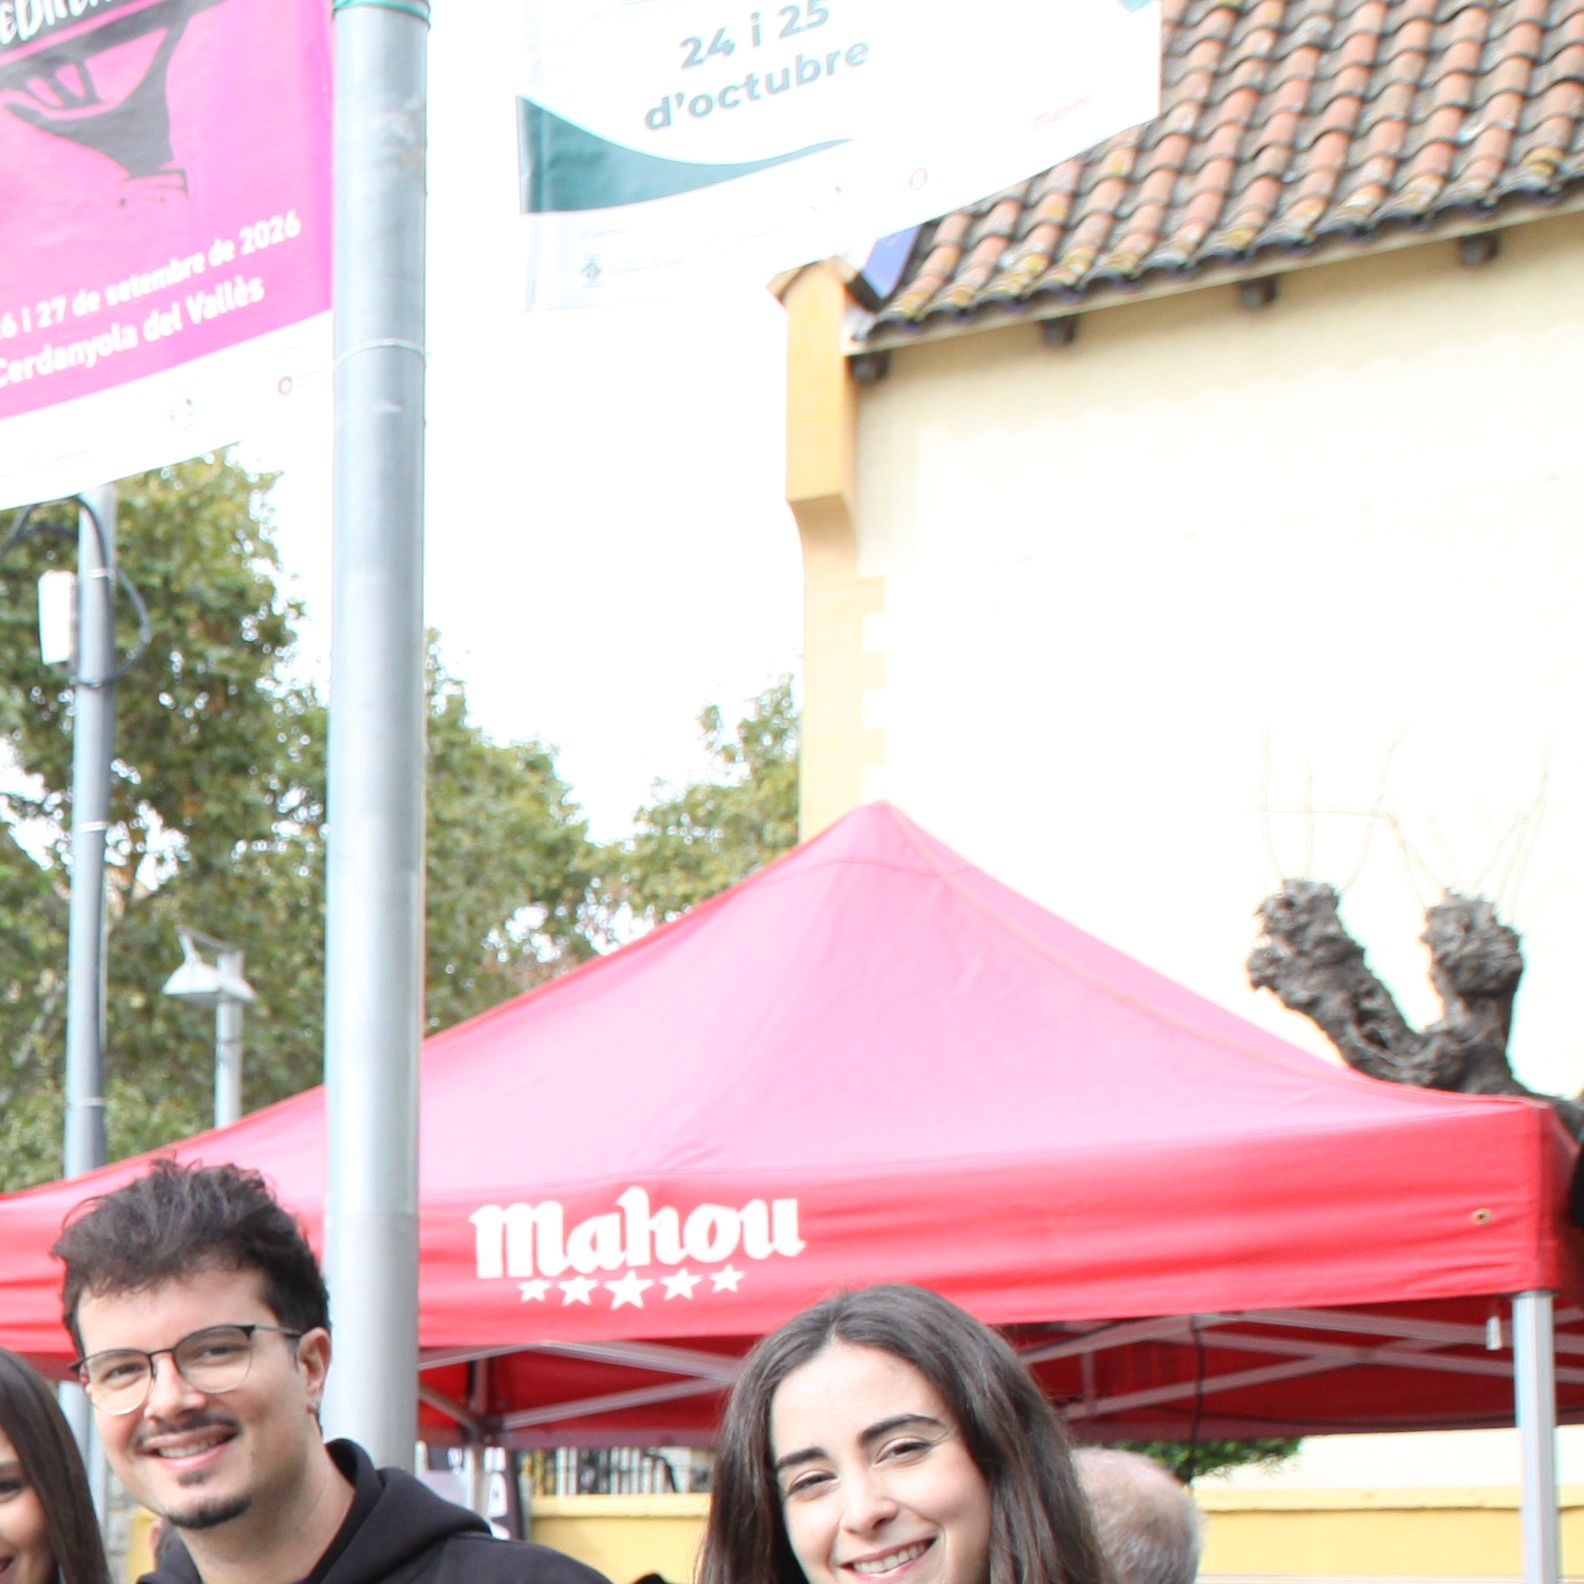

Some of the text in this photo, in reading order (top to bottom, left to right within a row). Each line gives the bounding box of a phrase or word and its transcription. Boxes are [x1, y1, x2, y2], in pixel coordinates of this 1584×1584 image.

[679, 0, 830, 70] 24 i 25
[22, 307, 32, 332] i
[35, 297, 67, 328] 27
[72, 288, 101, 316] de
[105, 250, 206, 306] setembre
[208, 238, 235, 267] de
[239, 209, 302, 255] 2026
[143, 301, 183, 341] del
[186, 275, 265, 325] Vallès
[469, 1186, 806, 1280] Mahou
